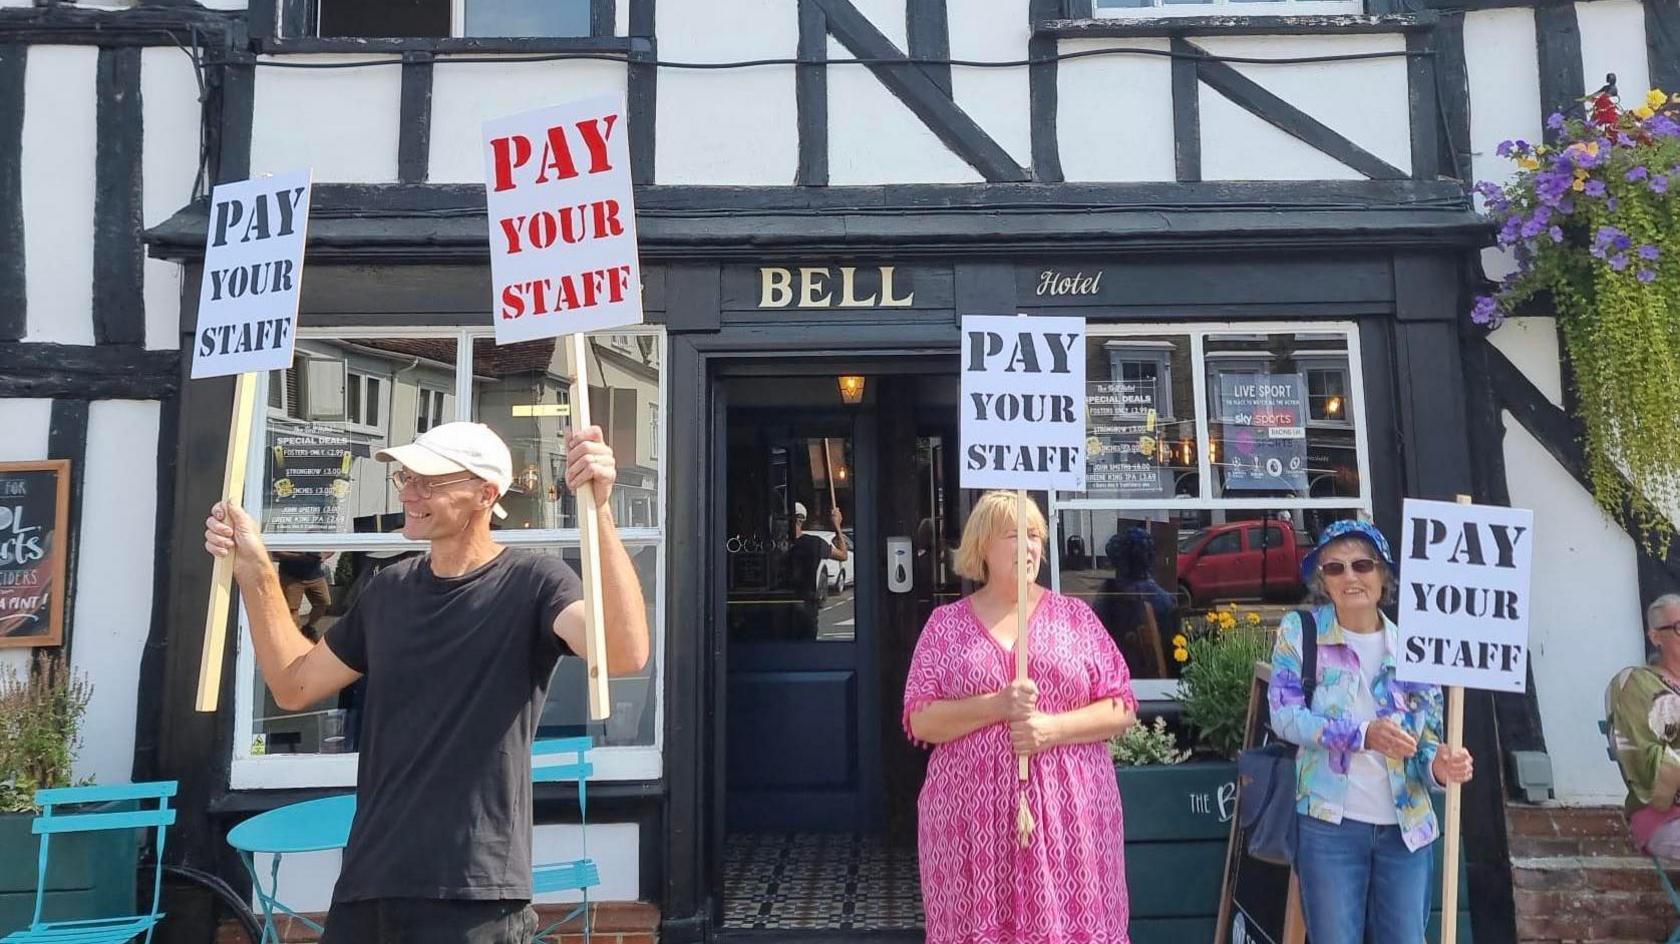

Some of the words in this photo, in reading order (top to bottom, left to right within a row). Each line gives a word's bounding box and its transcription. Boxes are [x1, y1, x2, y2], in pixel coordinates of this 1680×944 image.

[491, 115, 617, 191] PAY
[213, 187, 305, 247] PAY
[501, 200, 624, 254] YOUR
[211, 260, 293, 300] YOUR
[503, 266, 630, 318] STAFF
[758, 266, 914, 308] BELL
[1036, 269, 1103, 295] Hotel
[200, 318, 291, 357] STAFF
[967, 331, 1079, 374] PAY
[970, 392, 1077, 423] YOUR
[1086, 395, 1120, 403] PECIAL
[1122, 395, 1152, 403] DEALS
[1234, 385, 1255, 398] LIVE
[1259, 385, 1291, 398] SPORT
[1235, 413, 1252, 426] sky
[1254, 413, 1291, 425] sports
[967, 443, 1079, 473] STAFF
[6, 481, 26, 495] FOR
[1410, 518, 1526, 568] PAY
[1411, 583, 1520, 621] YOUR
[1405, 636, 1522, 672] STAFF
[1190, 794, 1211, 814] THE
